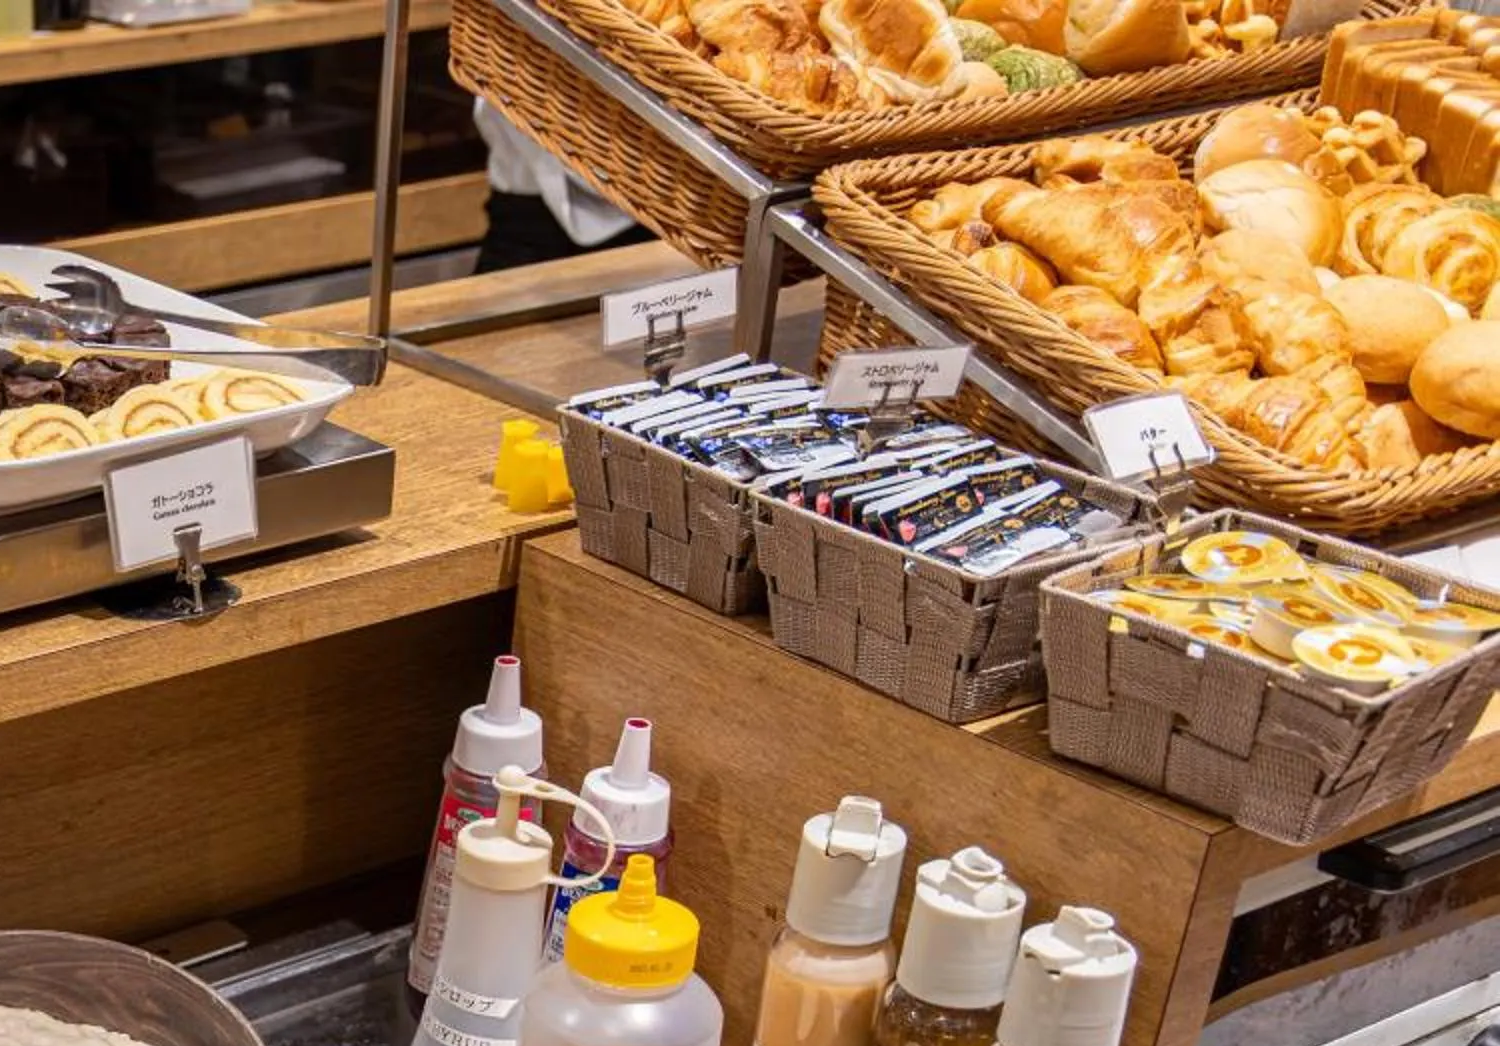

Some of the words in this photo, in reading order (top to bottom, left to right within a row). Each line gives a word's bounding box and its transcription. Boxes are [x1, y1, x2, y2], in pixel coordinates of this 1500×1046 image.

[631, 288, 713, 316] ブルーベリージャム
[862, 361, 940, 377] ストロベリージャム
[151, 481, 215, 509] ガトーショコラ
